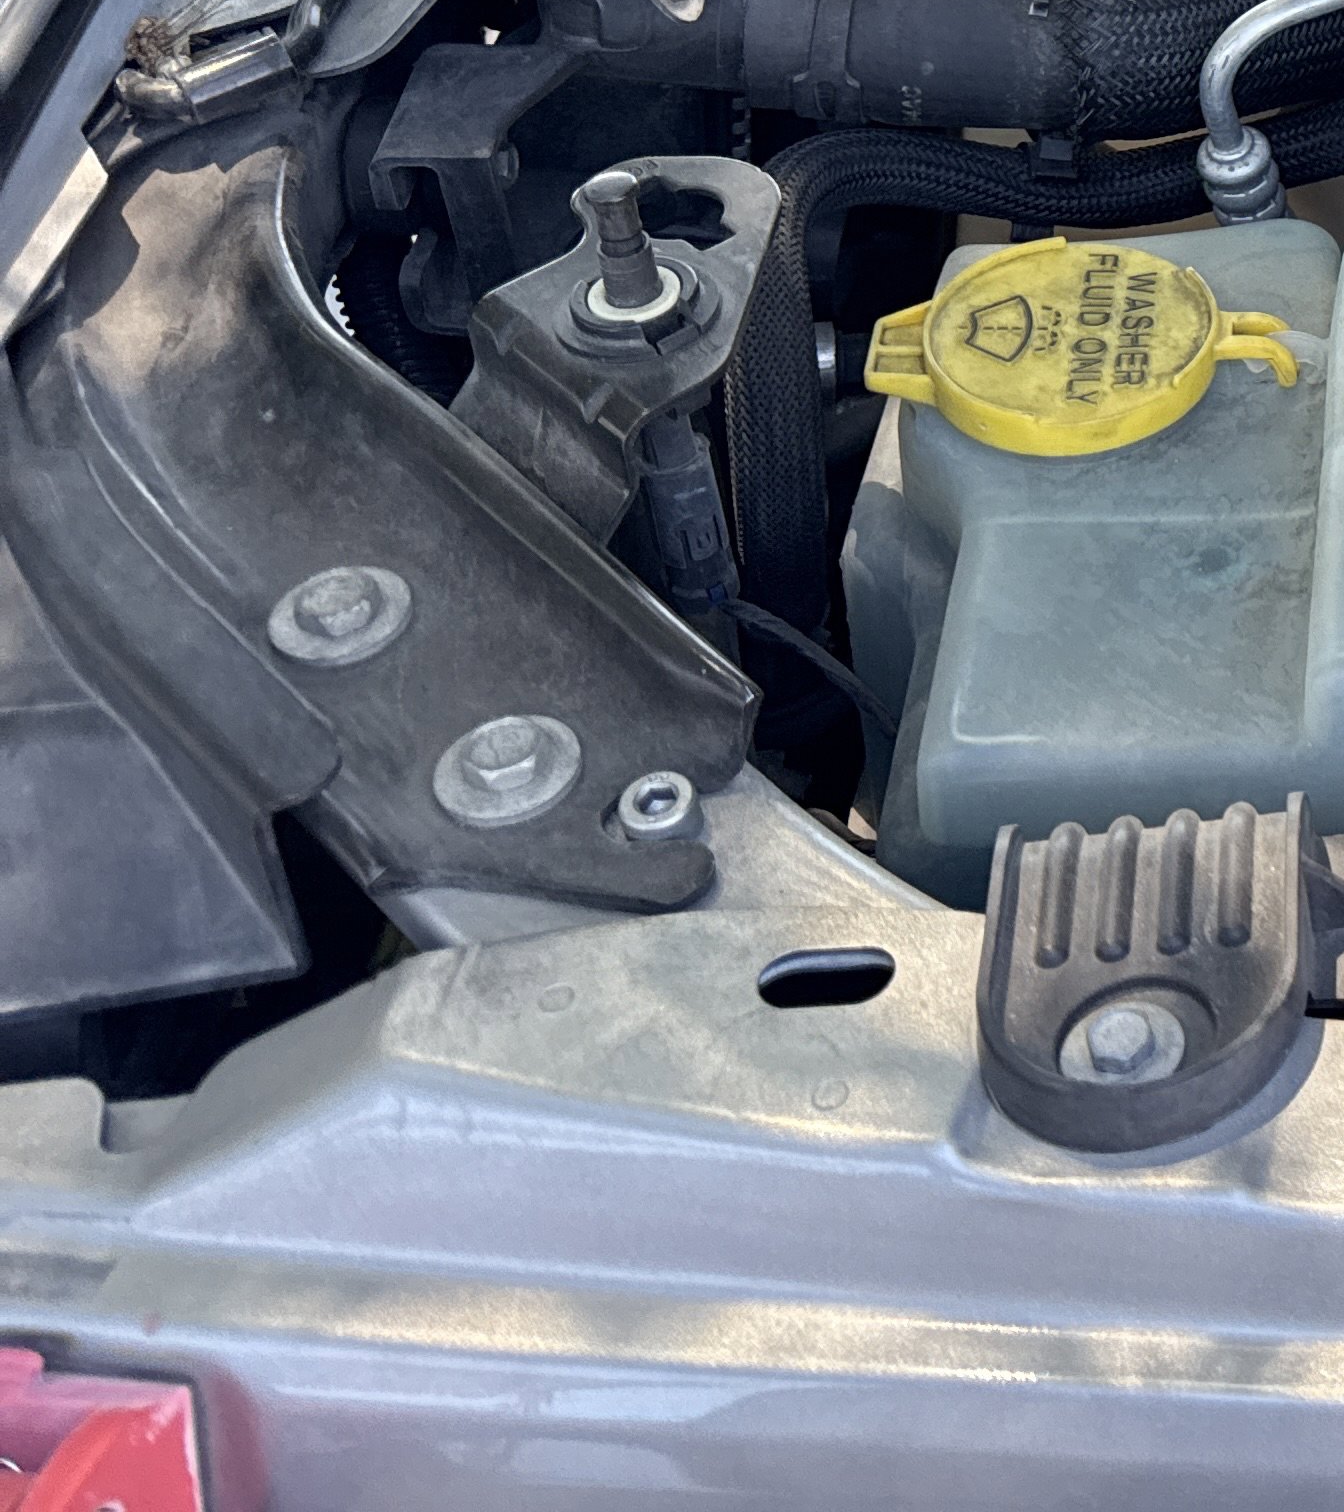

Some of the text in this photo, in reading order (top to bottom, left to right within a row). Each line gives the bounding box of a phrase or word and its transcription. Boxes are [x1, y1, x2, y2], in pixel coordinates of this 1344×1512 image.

[1065, 252, 1120, 407] FLUID ONLY
[1113, 271, 1159, 390] WASHER
